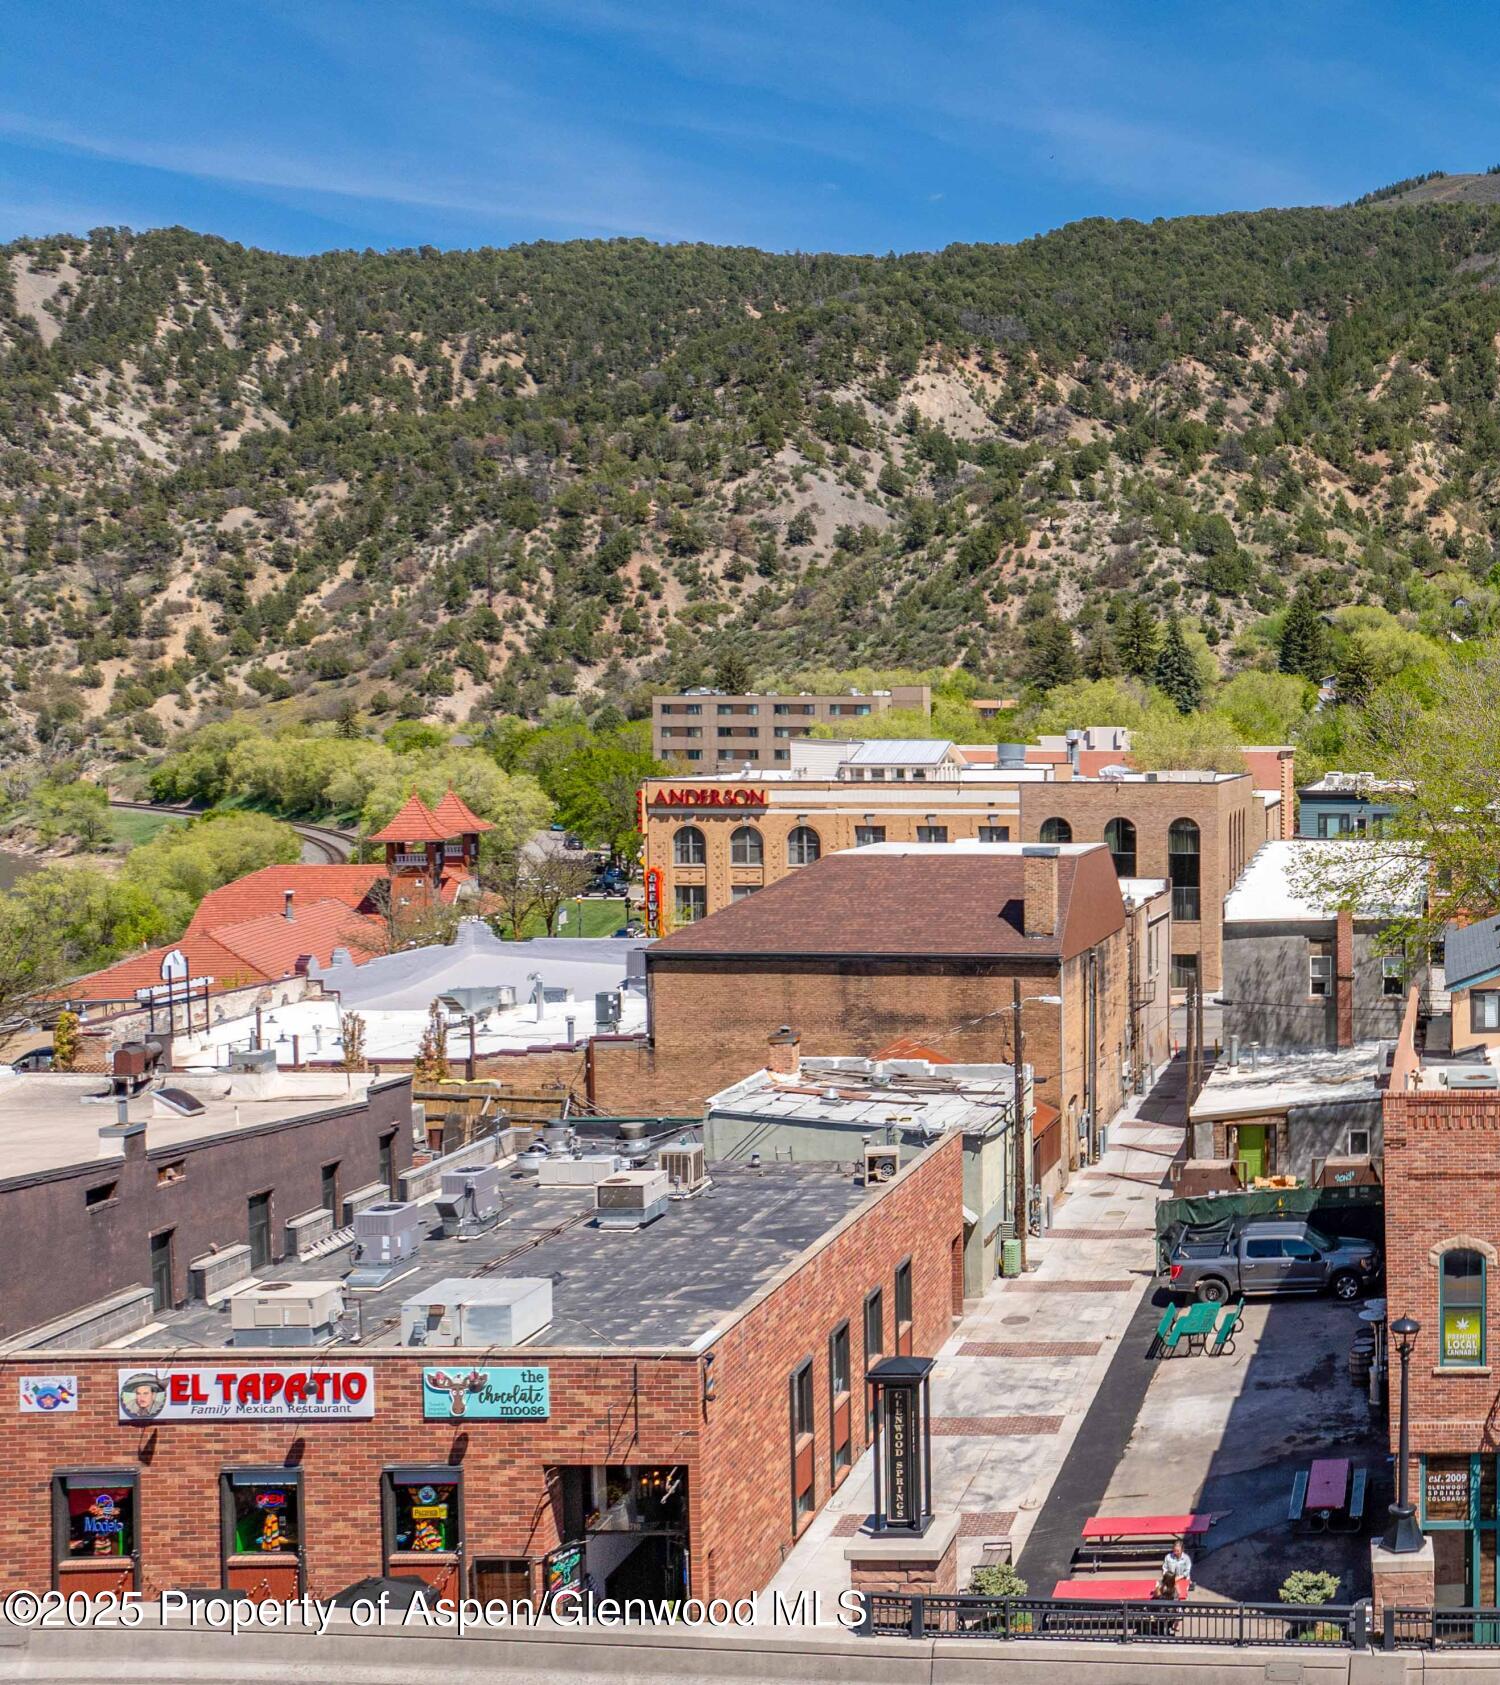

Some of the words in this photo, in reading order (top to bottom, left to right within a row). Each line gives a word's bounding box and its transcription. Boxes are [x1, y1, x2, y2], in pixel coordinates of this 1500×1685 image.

[655, 789, 765, 805] ANDERSON
[1448, 1340, 1477, 1350] LOCAL
[521, 1370, 544, 1383] the
[170, 1373, 209, 1404] EL
[215, 1372, 368, 1404] TAPATIO
[478, 1385, 544, 1404] chocolate
[191, 1405, 231, 1415] Family
[236, 1404, 283, 1414] Mexican
[288, 1404, 353, 1414] Restaurant
[500, 1406, 545, 1415] moose
[894, 1392, 905, 1456] GLENWOOD
[1445, 1473, 1467, 1482] 2009
[896, 1461, 905, 1518] SPRINGS
[84, 1517, 124, 1533] Modelo
